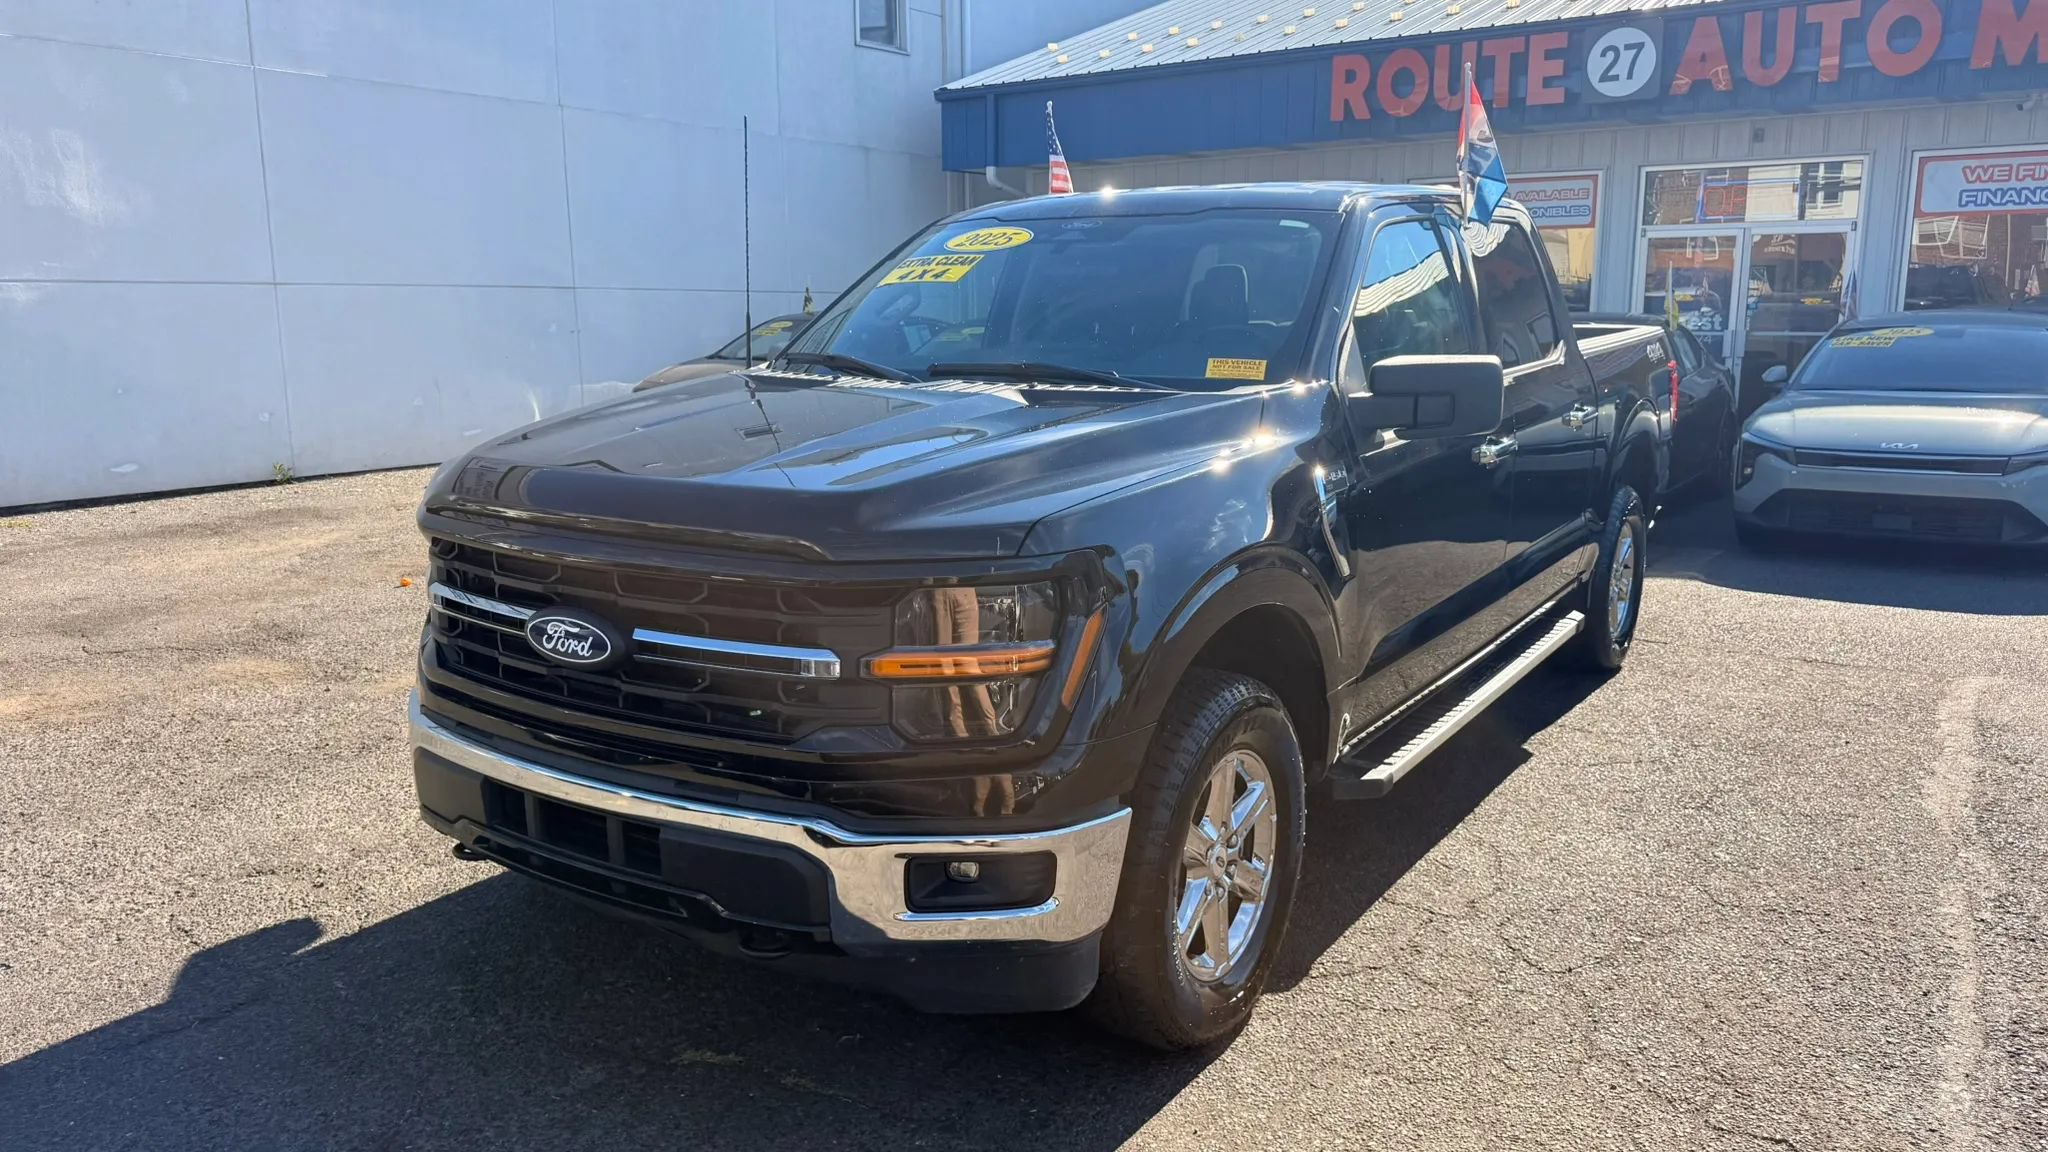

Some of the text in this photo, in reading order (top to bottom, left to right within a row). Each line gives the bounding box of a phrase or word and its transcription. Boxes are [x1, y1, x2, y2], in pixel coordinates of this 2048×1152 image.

[1329, 32, 1569, 121] ROUTE
[1597, 42, 1646, 84] 27
[1669, 0, 1943, 95] AUTO
[1962, 164, 2012, 184] WE
[1514, 188, 1590, 202] AVAILABLE
[1530, 205, 1591, 219] ONIBLES
[955, 231, 1022, 248] 2025
[898, 255, 981, 269] EXTRA CLEAN
[897, 267, 951, 281] 4X4
[542, 621, 594, 657] Ford
